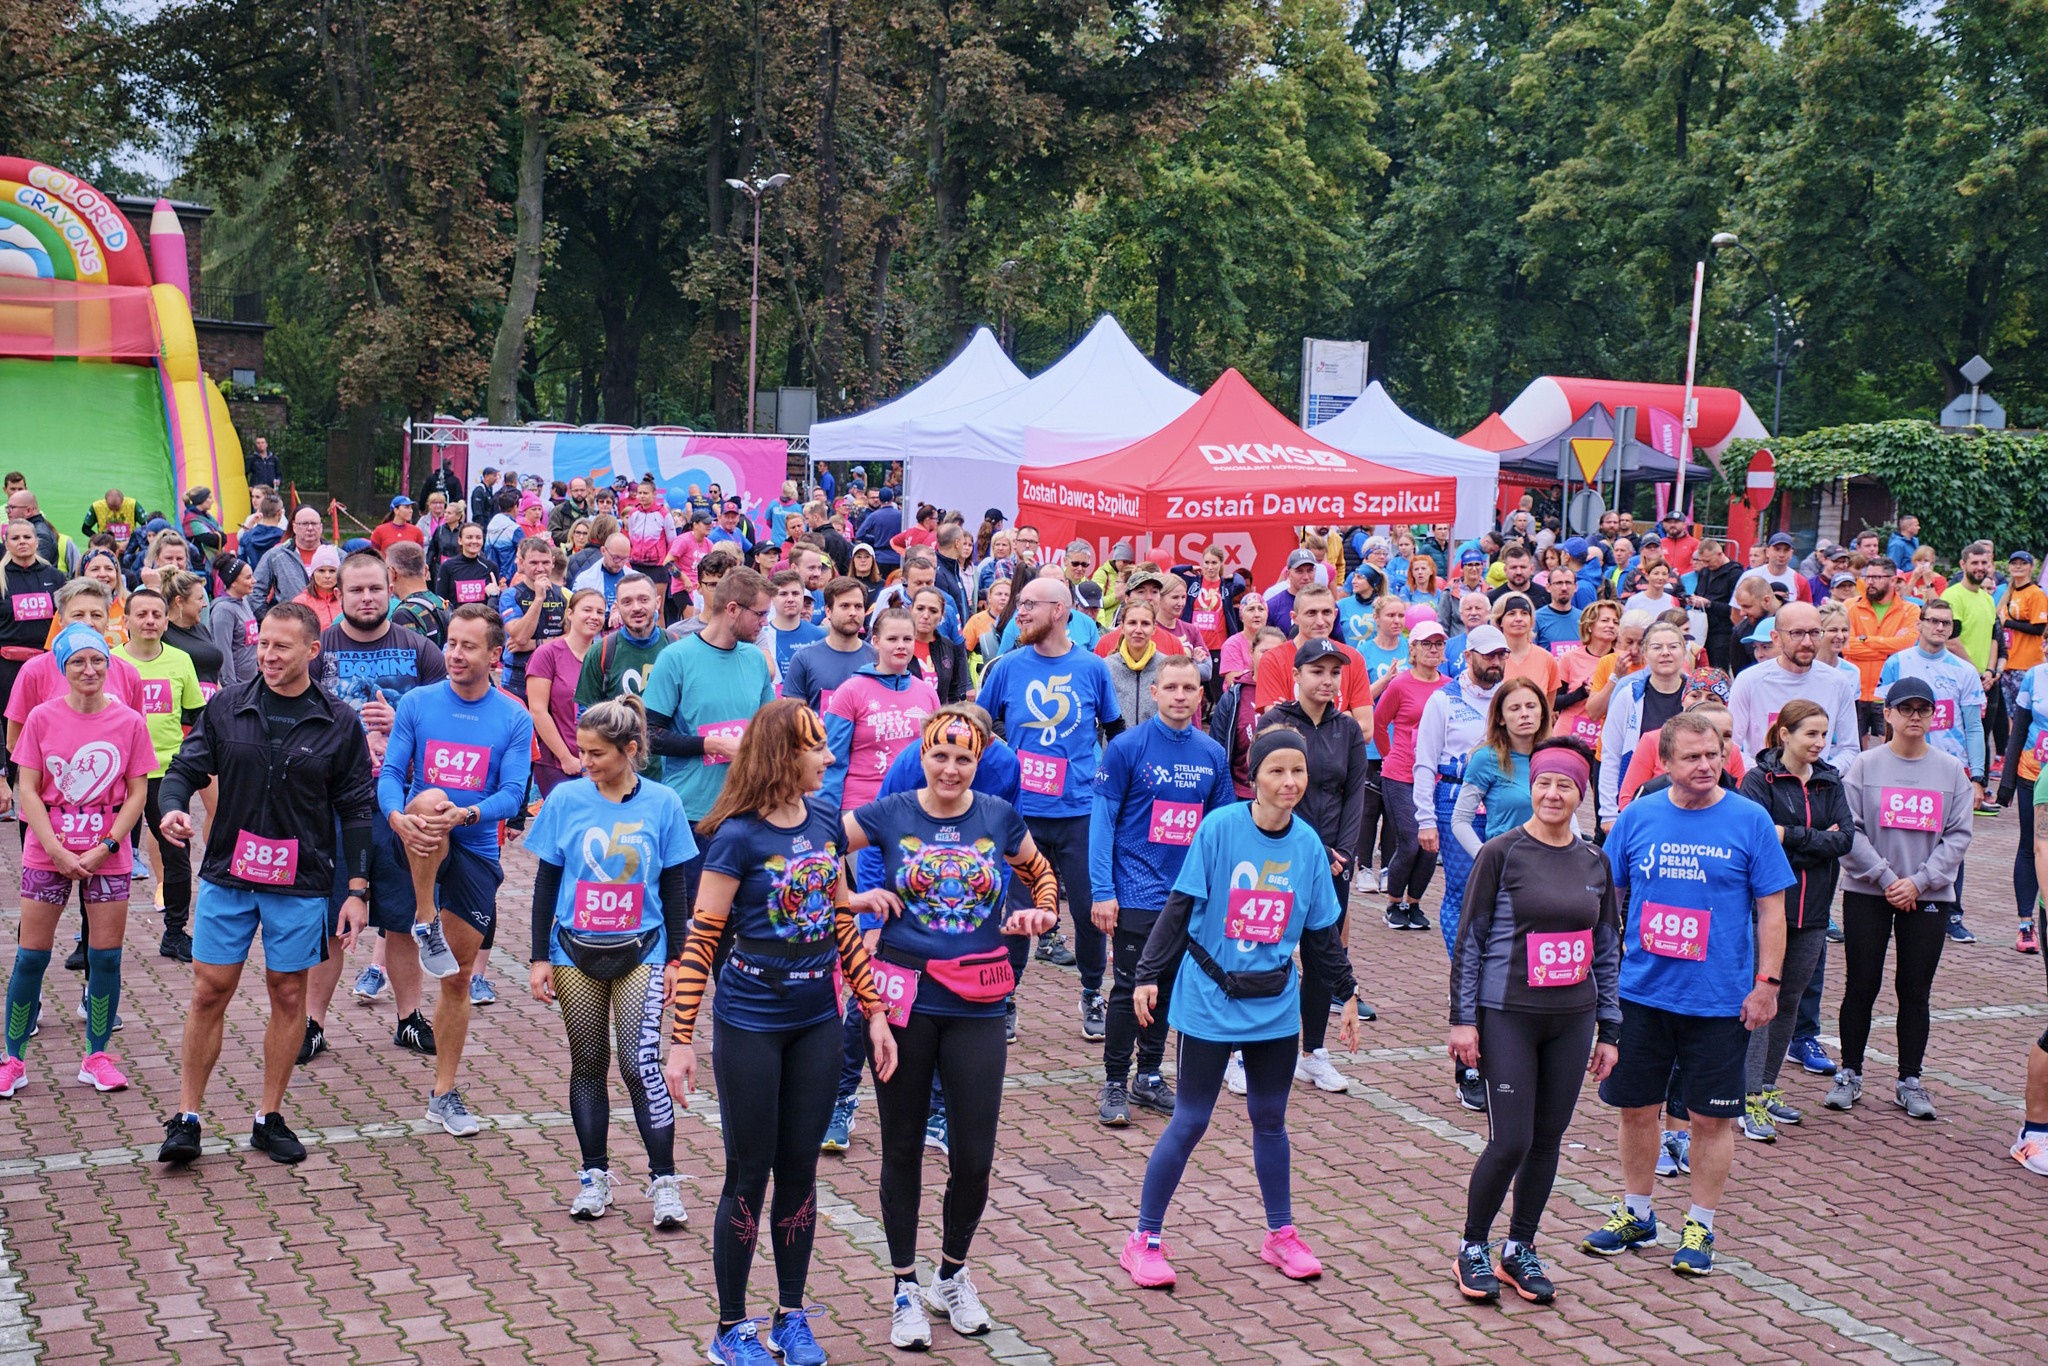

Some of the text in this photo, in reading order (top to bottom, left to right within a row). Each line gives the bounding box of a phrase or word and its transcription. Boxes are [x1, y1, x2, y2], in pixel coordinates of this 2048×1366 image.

[30, 168, 127, 248] COLORED
[18, 189, 100, 272] CRAYONS
[1198, 443, 1315, 465] DKMS
[1022, 479, 1140, 518] Zostań Dawcą Szpiku!
[1167, 491, 1441, 519] Zostań Dawcą Szpiku!
[461, 583, 482, 594] 559
[19, 596, 47, 610] 405
[1196, 613, 1215, 623] 655
[340, 649, 416, 659] MASTERS OF
[339, 659, 418, 678] BOXING
[1054, 685, 1072, 693] BIEG
[867, 710, 902, 726] RUSZ
[946, 727, 971, 737] HERO
[435, 748, 481, 772] 647
[1022, 757, 1057, 779] 535
[1174, 764, 1214, 776] STELLANTIS
[1174, 772, 1201, 781] ACTIVE
[1174, 780, 1197, 788] TEAM
[1889, 793, 1934, 814] 648
[61, 813, 104, 833] 379
[1160, 808, 1198, 829] 449
[620, 835, 643, 844] BIEG
[792, 834, 805, 844] JUST
[935, 832, 960, 842] HERO
[243, 841, 289, 867] 382
[1660, 842, 1732, 860] ODDYCHAJ
[1659, 854, 1699, 870] PEŁNĄ
[1267, 874, 1289, 886] BIEG
[1658, 866, 1707, 883] PIERSIĄ
[585, 889, 634, 912] 504
[1240, 897, 1286, 922] 473
[1648, 912, 1699, 939] 498
[1539, 939, 1586, 965] 638
